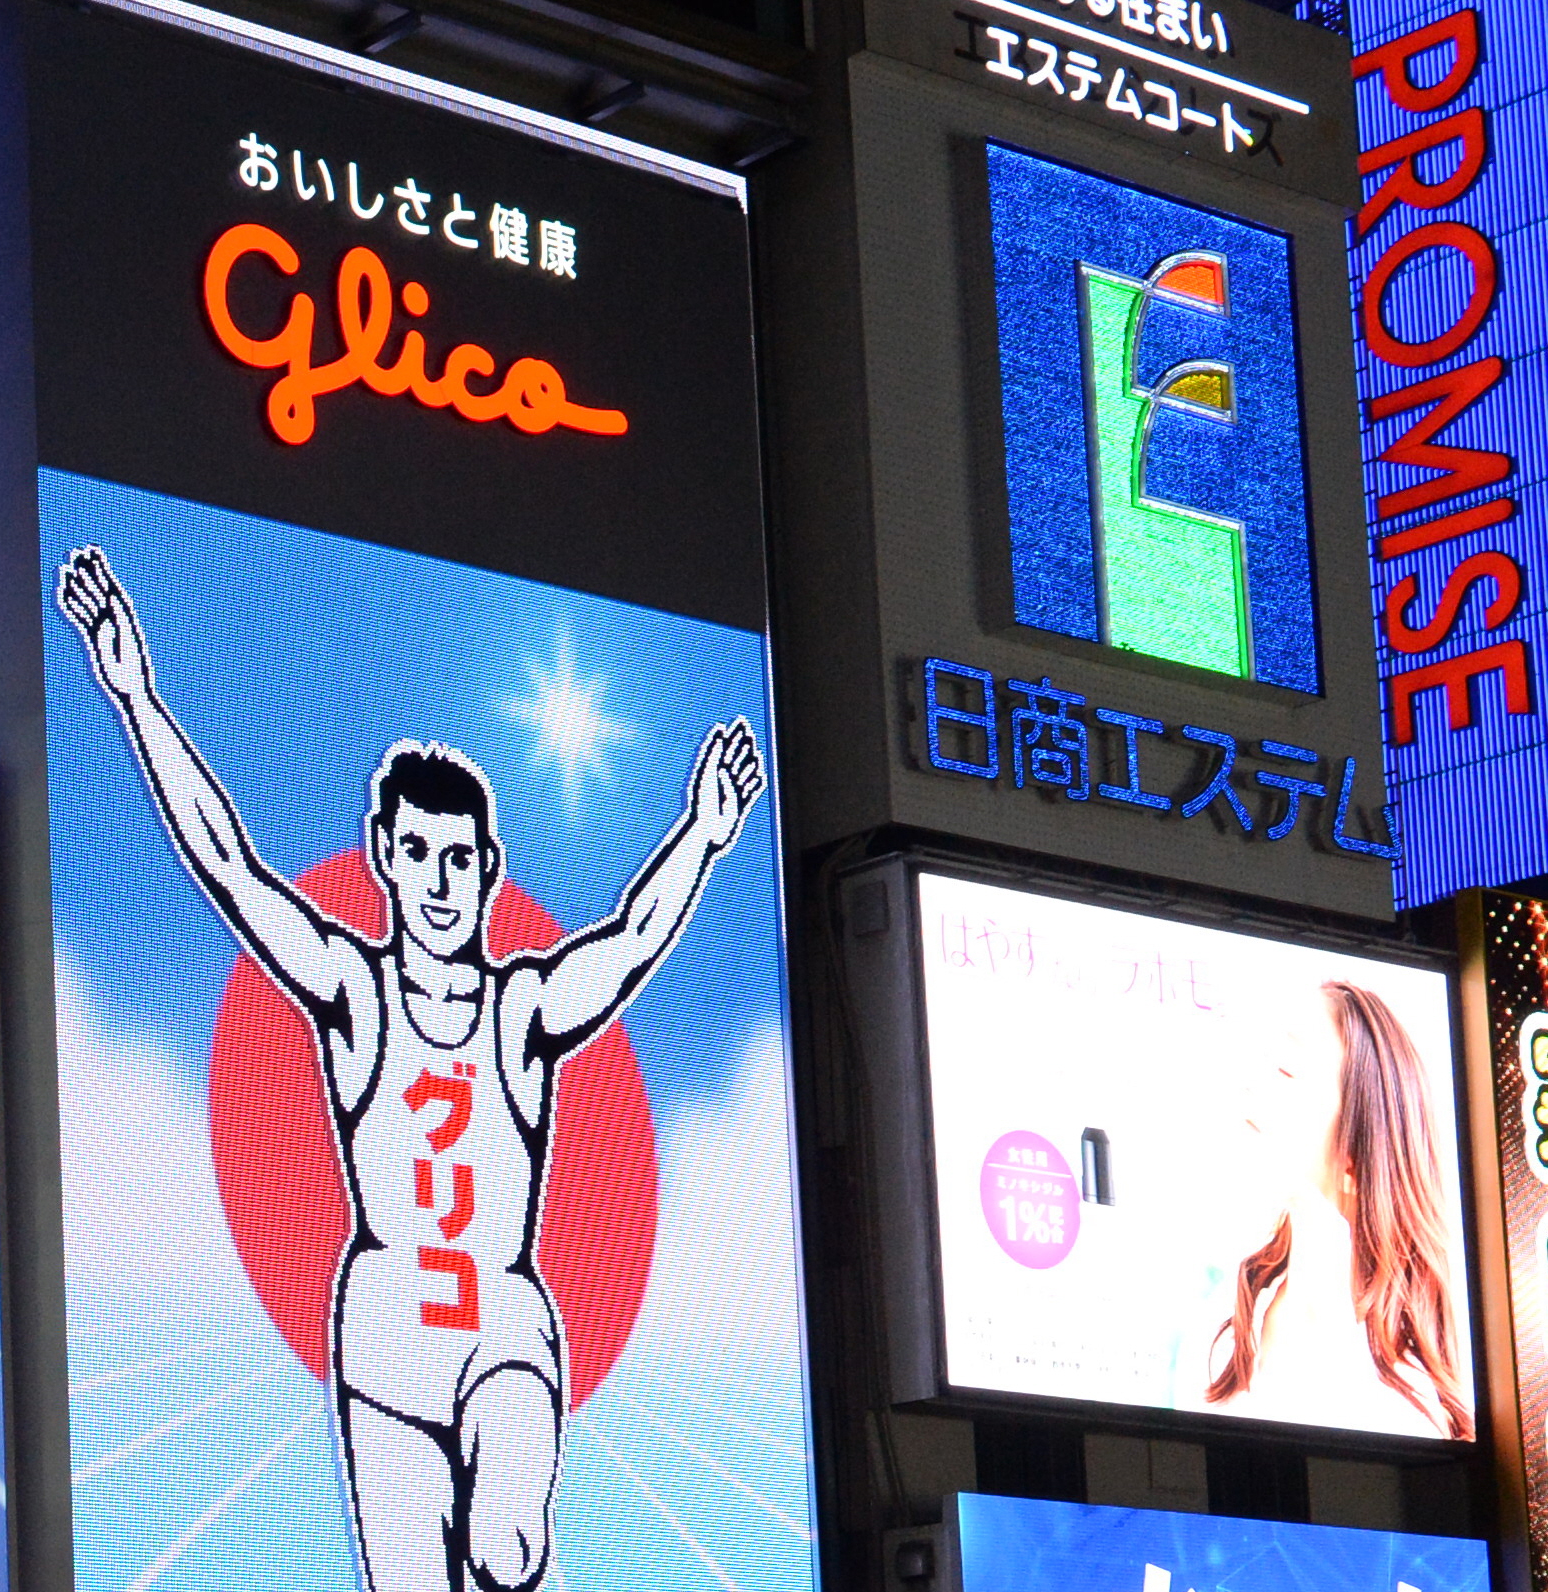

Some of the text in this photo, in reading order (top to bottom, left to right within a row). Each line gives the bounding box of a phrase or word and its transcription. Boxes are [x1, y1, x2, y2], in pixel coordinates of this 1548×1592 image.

[986, 26, 1255, 153] エステムコート
[237, 131, 578, 281] おいしさと健康
[204, 223, 629, 446] Glico
[1350, 7, 1531, 747] PROMISE
[923, 656, 1402, 861] 日商エステム
[402, 1061, 481, 1332] グリコ
[998, 1194, 1050, 1245] 1%
